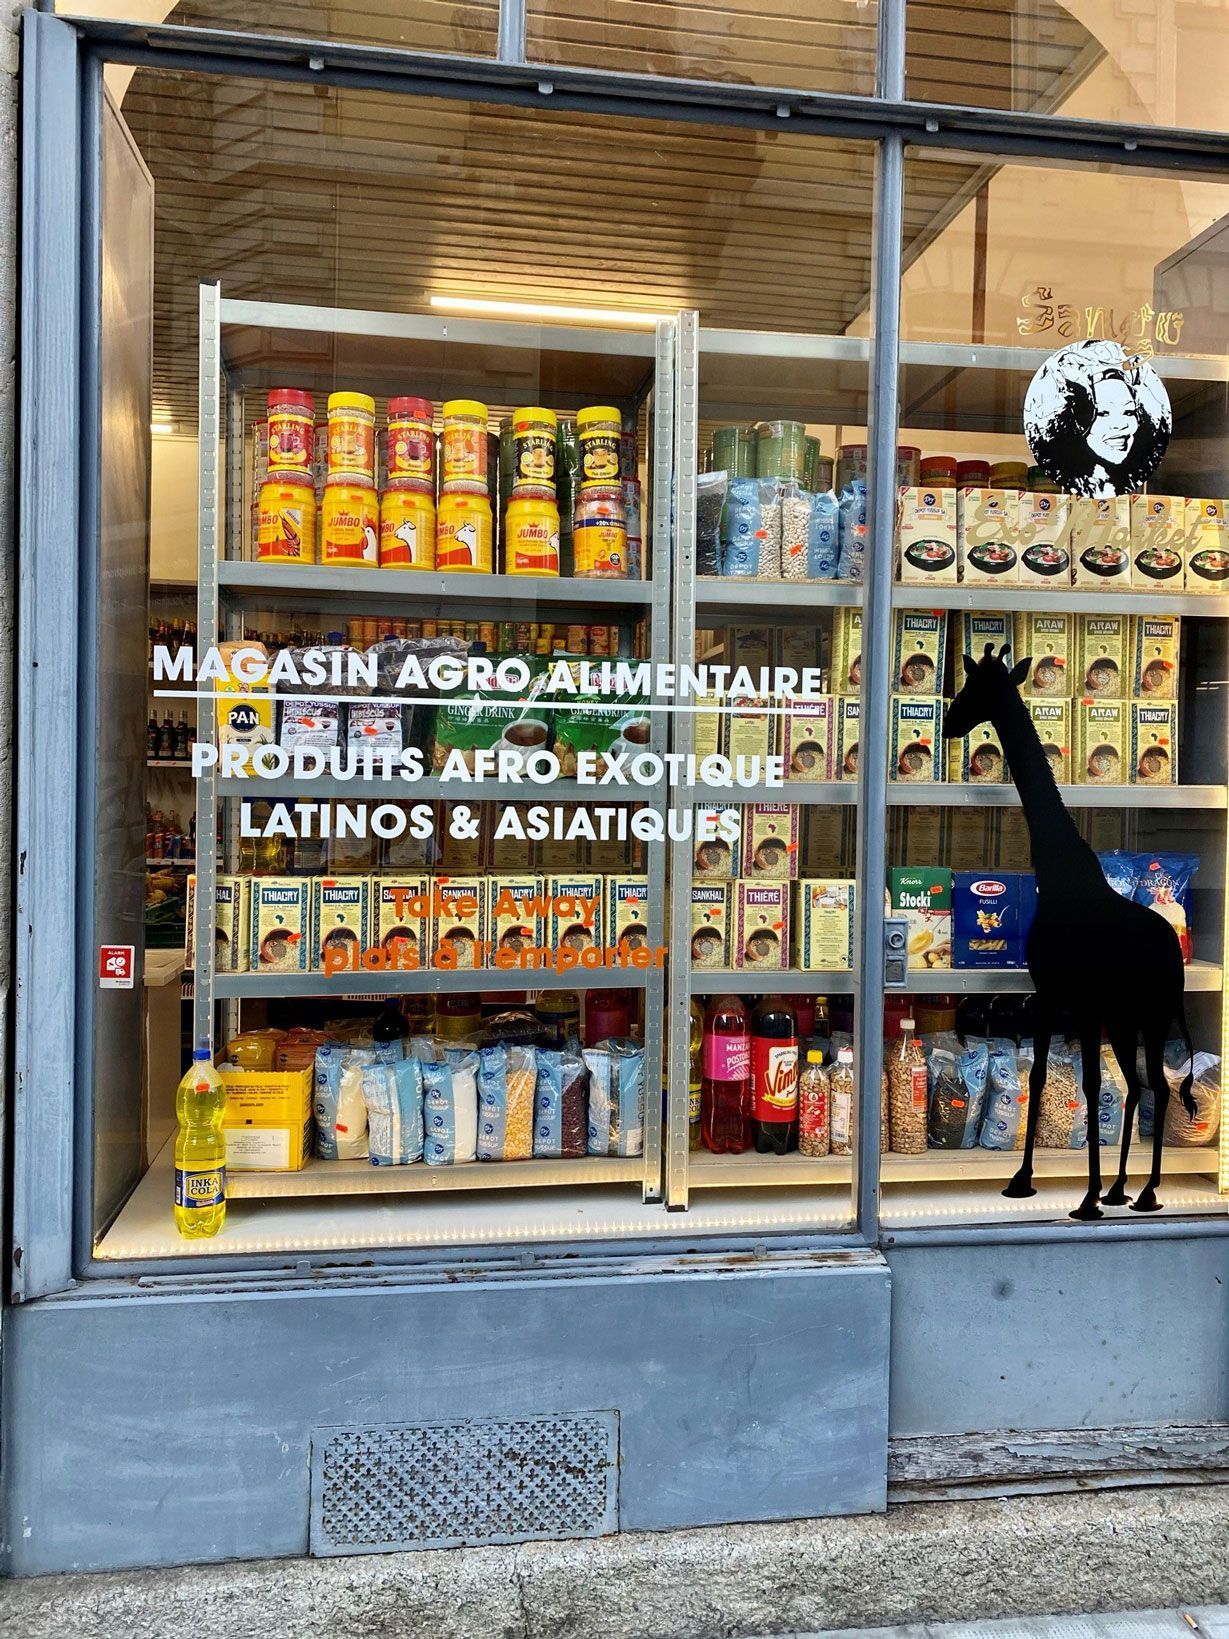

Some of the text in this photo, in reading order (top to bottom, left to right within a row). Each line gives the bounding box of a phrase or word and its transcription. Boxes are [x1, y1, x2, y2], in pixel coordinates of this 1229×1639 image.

[271, 422, 305, 434] STARLING
[397, 431, 430, 444] STARLING
[522, 438, 553, 452] STARLING
[584, 439, 617, 450] STARLING
[260, 514, 279, 525] MBO
[327, 516, 361, 528] JUMBO
[517, 528, 549, 539] JUMBO
[906, 617, 937, 629] THIACRY
[974, 620, 1003, 631] THIACRY
[1145, 624, 1173, 635] THIACRY
[154, 645, 378, 687] MAGASIN
[394, 654, 531, 692] AGRO
[545, 660, 821, 700] ALIMENTAIRE
[447, 704, 516, 719] GINGR DRINK
[902, 706, 933, 718] THIACRY
[1140, 711, 1169, 722] THIACRY
[191, 742, 785, 788] PRODUITS AFRO EXOTIQUE
[240, 803, 741, 843] LATINOS & ASIATIQUES
[620, 887, 647, 898] THIACR
[978, 884, 1004, 892] Barilla
[263, 890, 298, 902] THIACRY
[323, 890, 359, 901] THIACRY
[692, 890, 724, 901] SANKHAL
[899, 890, 931, 907] Stocki
[391, 888, 601, 924] Take Away
[324, 938, 668, 979] plats à l'emporter
[726, 1043, 750, 1052] MANZA
[191, 1178, 218, 1187] INKA
[191, 1186, 218, 1195] COLA
